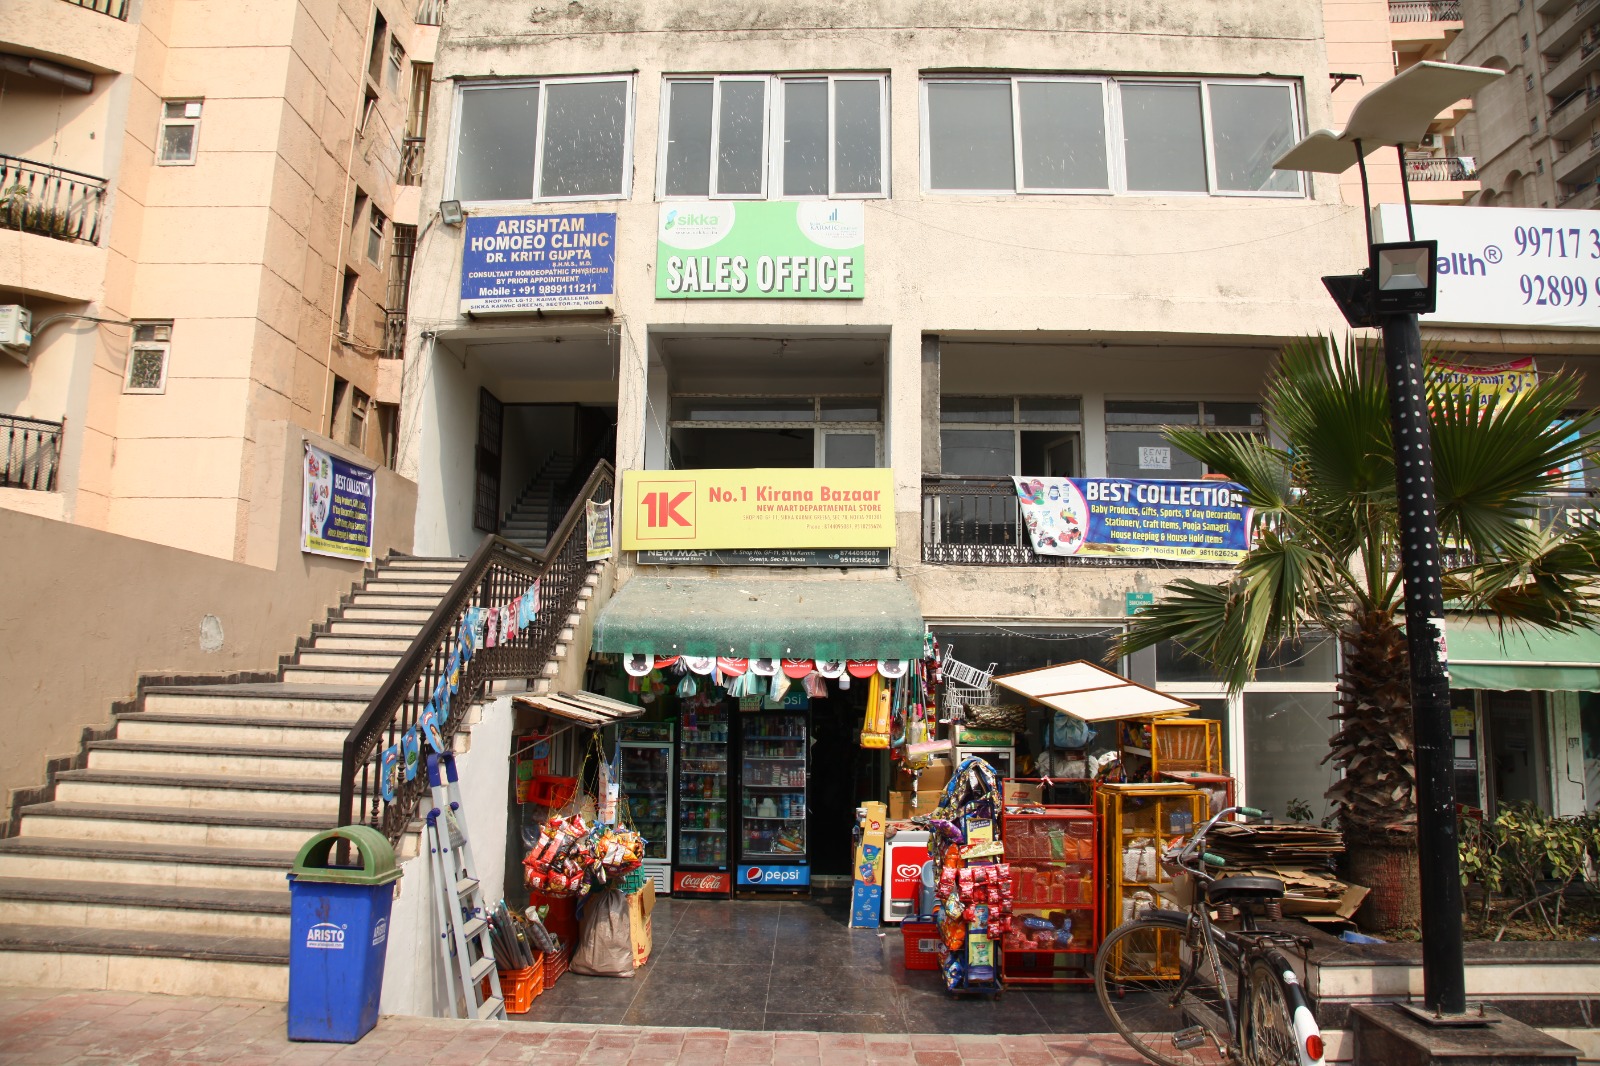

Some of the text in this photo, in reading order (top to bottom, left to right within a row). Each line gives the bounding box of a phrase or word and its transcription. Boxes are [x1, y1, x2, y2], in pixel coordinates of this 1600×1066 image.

[496, 218, 585, 234] ARISHTAM
[678, 214, 718, 226] sikka
[471, 232, 609, 251] HOMOEO CLINIC
[1514, 226, 1580, 258] 99717
[486, 250, 592, 263] DR. KRITI GUPTA
[468, 266, 609, 278] CONSULTANT HOMOEOPATHIC PHYSICIAN
[666, 255, 854, 292] SALES OFFICE
[530, 276, 580, 284] APPOINTMENT
[479, 286, 510, 296] Mobile
[518, 286, 536, 294] +91
[539, 284, 596, 294] 9899111211
[1520, 274, 1588, 307] 92899
[1433, 372, 1468, 384] HOTO
[1472, 375, 1504, 385] PRINT
[1144, 448, 1168, 456] RENT
[1144, 456, 1168, 464] SALE
[334, 474, 346, 490] BEST
[1086, 482, 1243, 508] BEST COLLECTION
[640, 486, 881, 528] 1K No.1 Kirana Bazaar
[756, 504, 882, 512] NEW MART DEPARTMENTAL STORE
[1090, 504, 1108, 516] Baby
[1109, 505, 1140, 516] Products,
[1141, 507, 1158, 518] Gifts,
[1160, 508, 1184, 519] Sports,
[1205, 510, 1243, 522] Decoration,
[1104, 518, 1231, 534] Stationery, Craft Items, Pooja Samagri,
[1110, 530, 1131, 540] House
[1132, 531, 1159, 543] Keeping
[1166, 532, 1187, 542] House
[1188, 534, 1204, 543] Hold
[1204, 534, 1224, 544] Items
[1180, 548, 1197, 556] Mob.
[1199, 549, 1239, 558] 9811626254
[765, 870, 800, 882] pepsi
[307, 929, 344, 942] ARISTO
